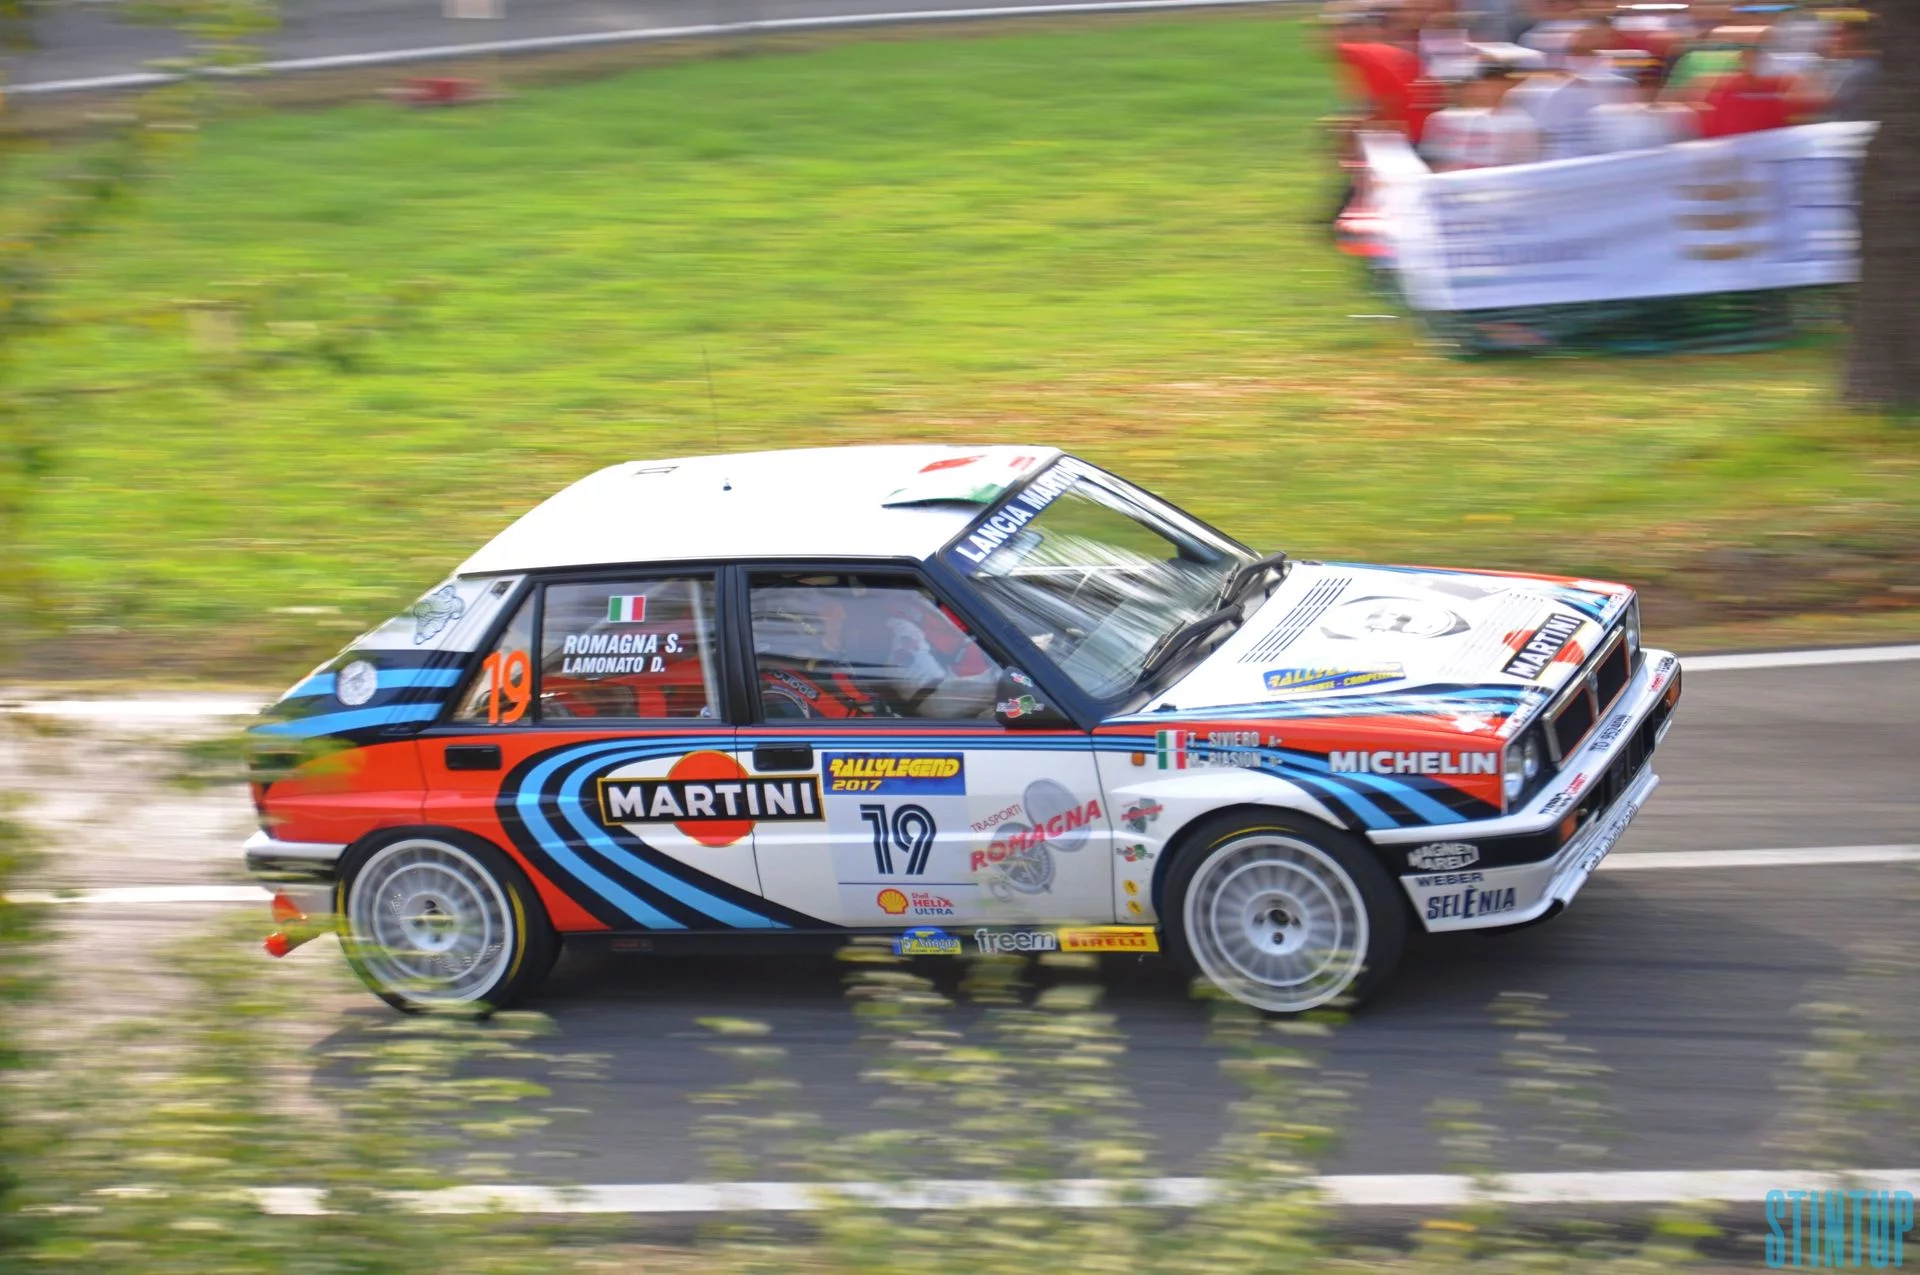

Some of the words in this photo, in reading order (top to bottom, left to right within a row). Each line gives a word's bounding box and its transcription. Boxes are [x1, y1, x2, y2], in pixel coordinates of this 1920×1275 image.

[956, 504, 1034, 564] LANCIA
[1017, 458, 1084, 511] MARTIN
[562, 634, 657, 654] ROMAGNA
[665, 633, 683, 653] S.
[1506, 614, 1581, 679] MARTINI
[562, 656, 643, 673] LAMONATO
[650, 656, 665, 673] D.
[483, 649, 532, 725] 19
[1208, 731, 1260, 748] SIVIERO
[829, 758, 960, 778] RALLYLEGEND
[1329, 750, 1497, 774] MICHELIN
[831, 780, 882, 791] 2017
[608, 783, 815, 818] MARTINI
[970, 804, 1023, 833] TRASPORTI
[860, 804, 937, 875] 19
[970, 799, 1102, 872] ROMAGNA
[1416, 872, 1485, 887] WEBER
[913, 899, 953, 908] HELIX
[975, 928, 1056, 953] freem
[1068, 932, 1147, 948] PIRELLI
